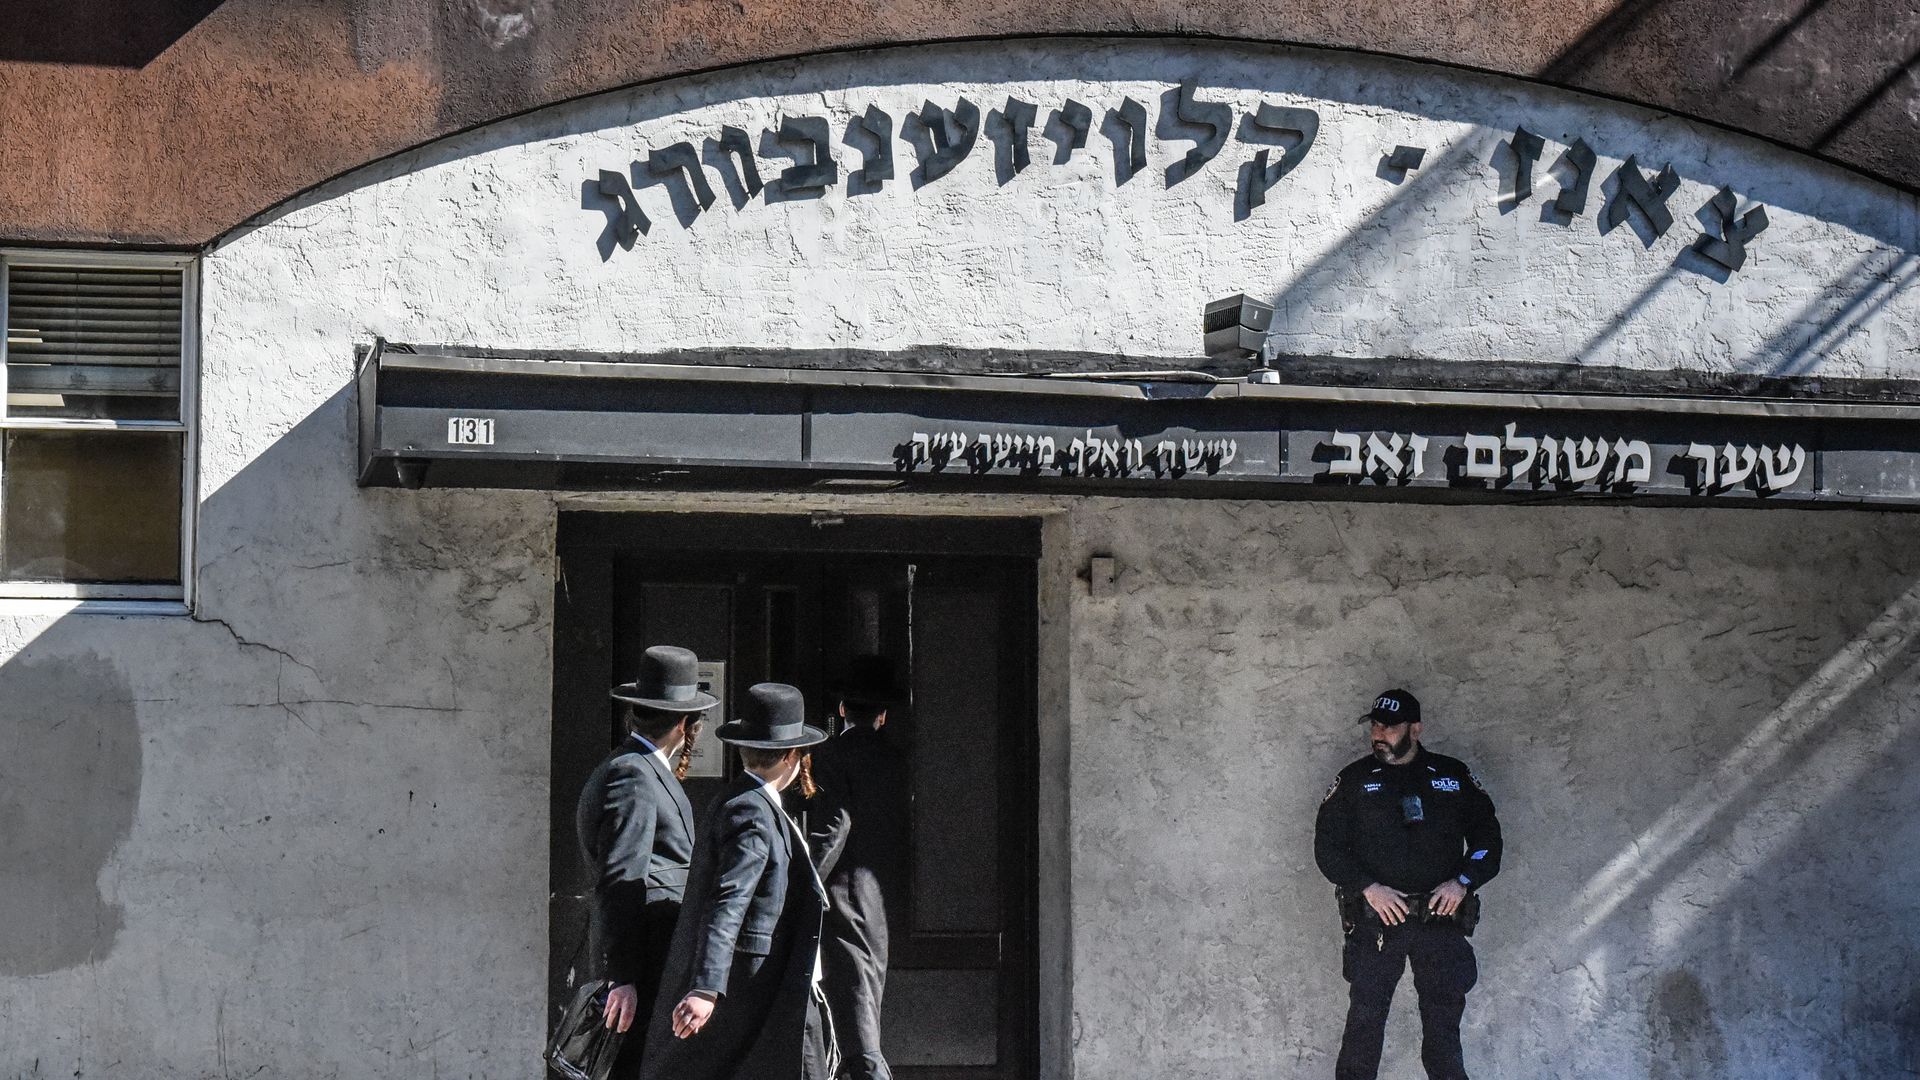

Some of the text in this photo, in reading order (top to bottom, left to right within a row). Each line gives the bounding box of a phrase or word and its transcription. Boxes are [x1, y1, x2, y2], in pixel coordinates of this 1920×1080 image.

[599, 77, 1320, 252] קלויזענבורג
[1510, 125, 1769, 271] צאנז
[452, 419, 490, 444] 131
[978, 432, 1055, 465] מייער
[1070, 429, 1143, 474] וואלף
[1329, 421, 1806, 490] שער משולם זאב
[1372, 697, 1400, 712] YPD
